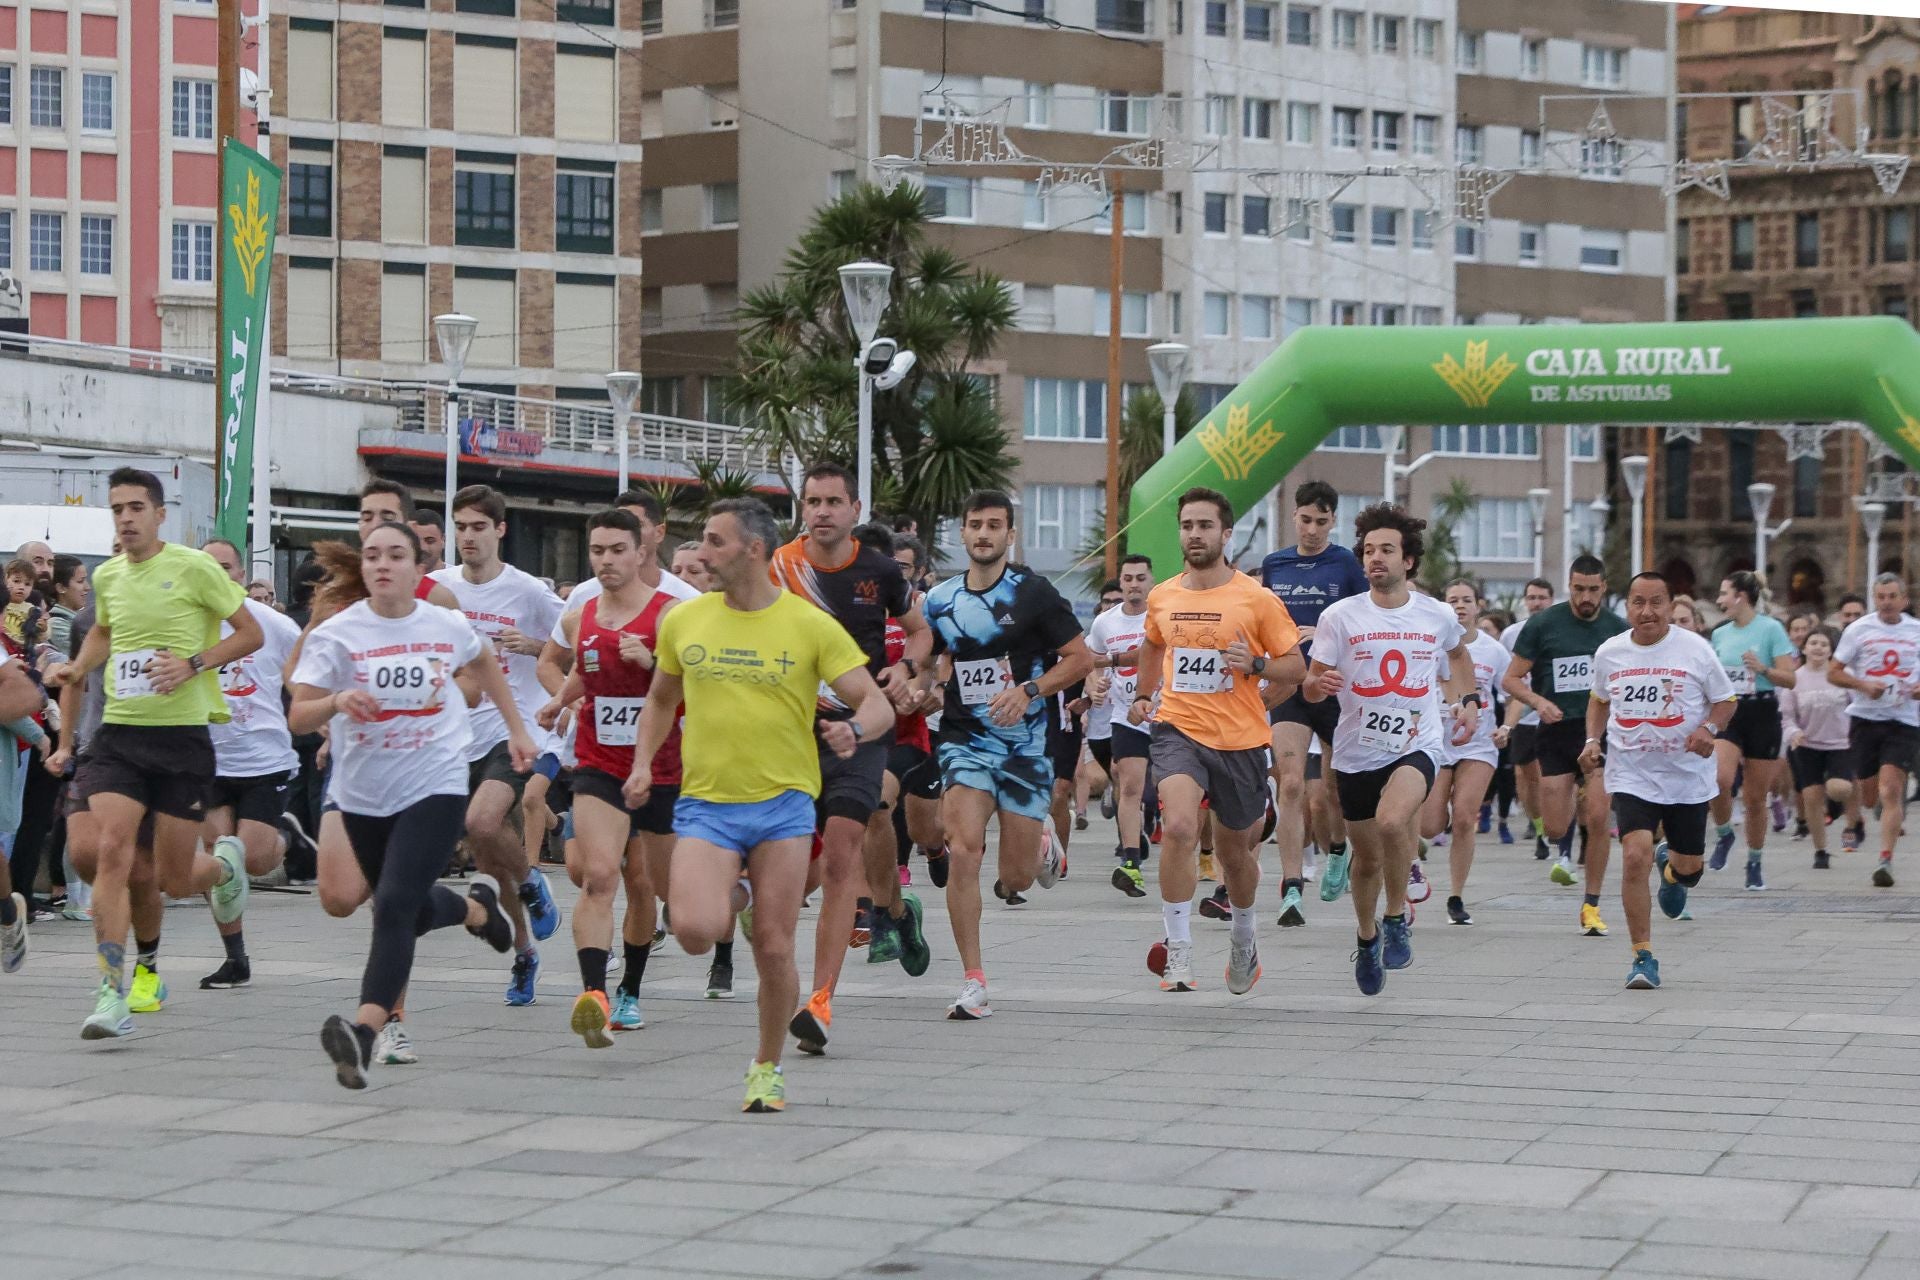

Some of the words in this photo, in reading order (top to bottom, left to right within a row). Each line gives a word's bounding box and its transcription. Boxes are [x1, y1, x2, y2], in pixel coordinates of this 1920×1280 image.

[1525, 348, 1607, 378] CAJA
[1614, 346, 1731, 376] RURAL
[1530, 385, 1561, 402] DE
[1566, 384, 1672, 402] ASTURIAS
[1348, 633, 1366, 646] XXIV
[1367, 632, 1401, 641] CARRERA
[1178, 656, 1215, 676] 244
[1558, 662, 1588, 679] 246
[376, 666, 424, 688] 089
[962, 667, 996, 687] 242
[1624, 685, 1658, 702] 248
[601, 706, 643, 726] 247
[1365, 711, 1405, 736] 262
